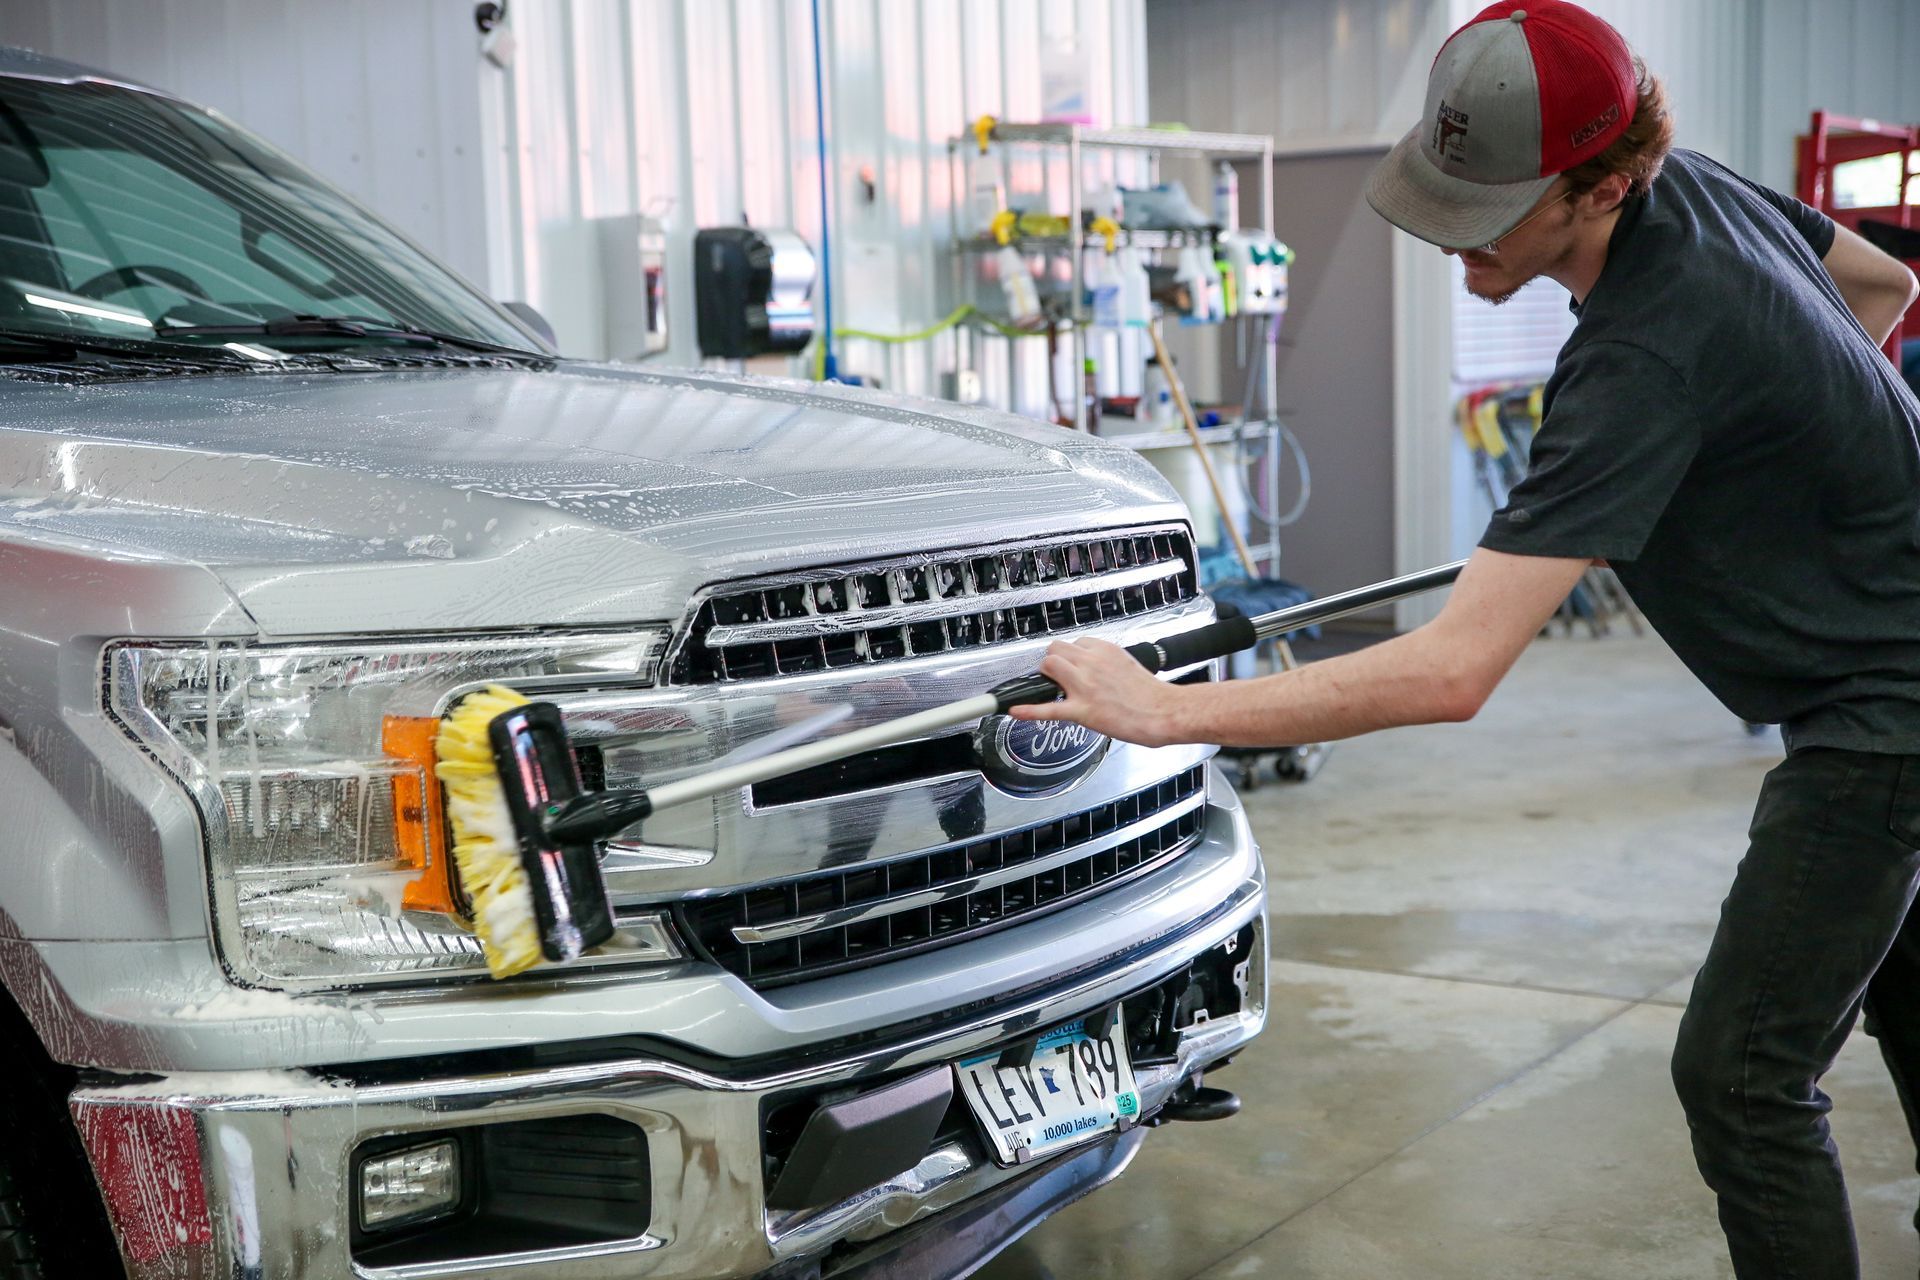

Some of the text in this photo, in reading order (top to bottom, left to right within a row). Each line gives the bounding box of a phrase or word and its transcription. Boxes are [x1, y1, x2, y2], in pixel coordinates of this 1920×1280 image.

[1031, 720, 1090, 758] Ford
[970, 1037, 1120, 1129] LEV 789
[1120, 1094, 1132, 1107] 25
[1043, 1114, 1098, 1141] 10,000 lakes
[1004, 1131, 1025, 1153] AUG
